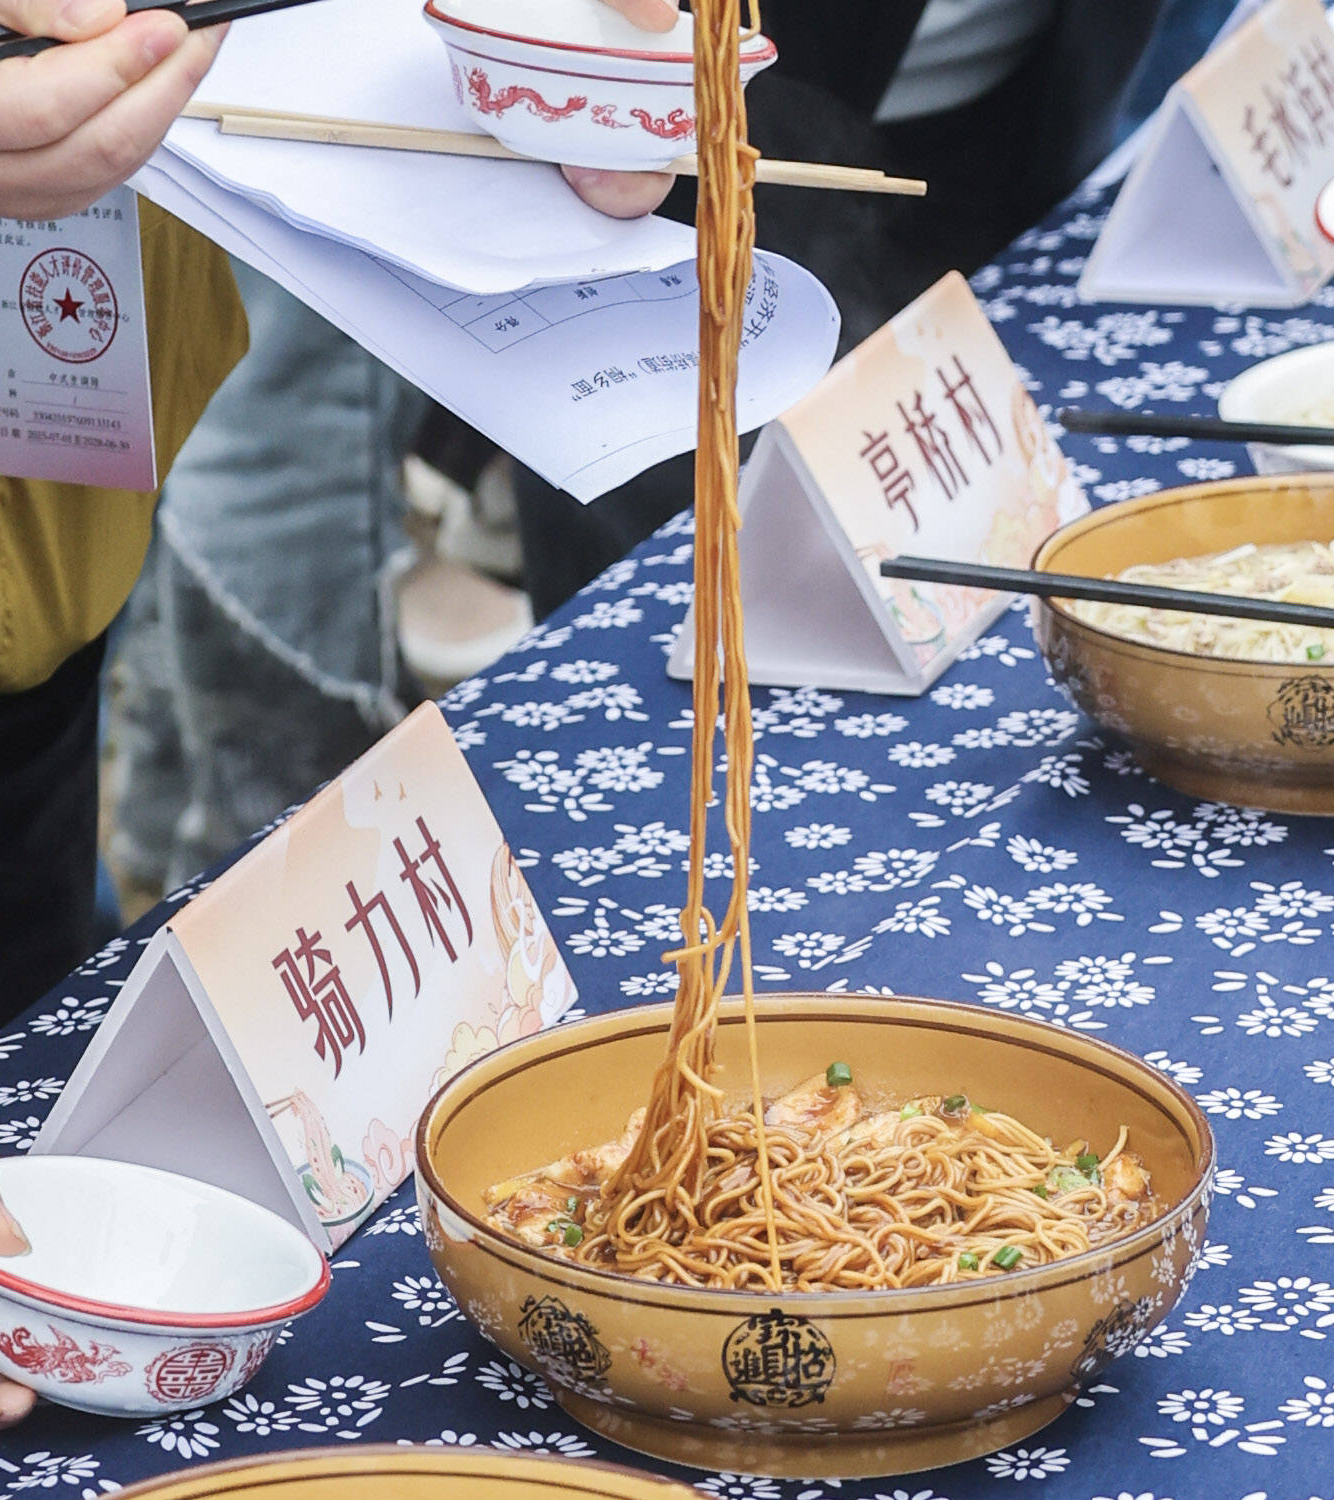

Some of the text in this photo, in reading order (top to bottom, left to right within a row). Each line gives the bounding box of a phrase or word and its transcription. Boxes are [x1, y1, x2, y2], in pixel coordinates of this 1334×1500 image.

[859, 354, 1003, 533] 亭桥村
[271, 815, 474, 1082] 骑力村
